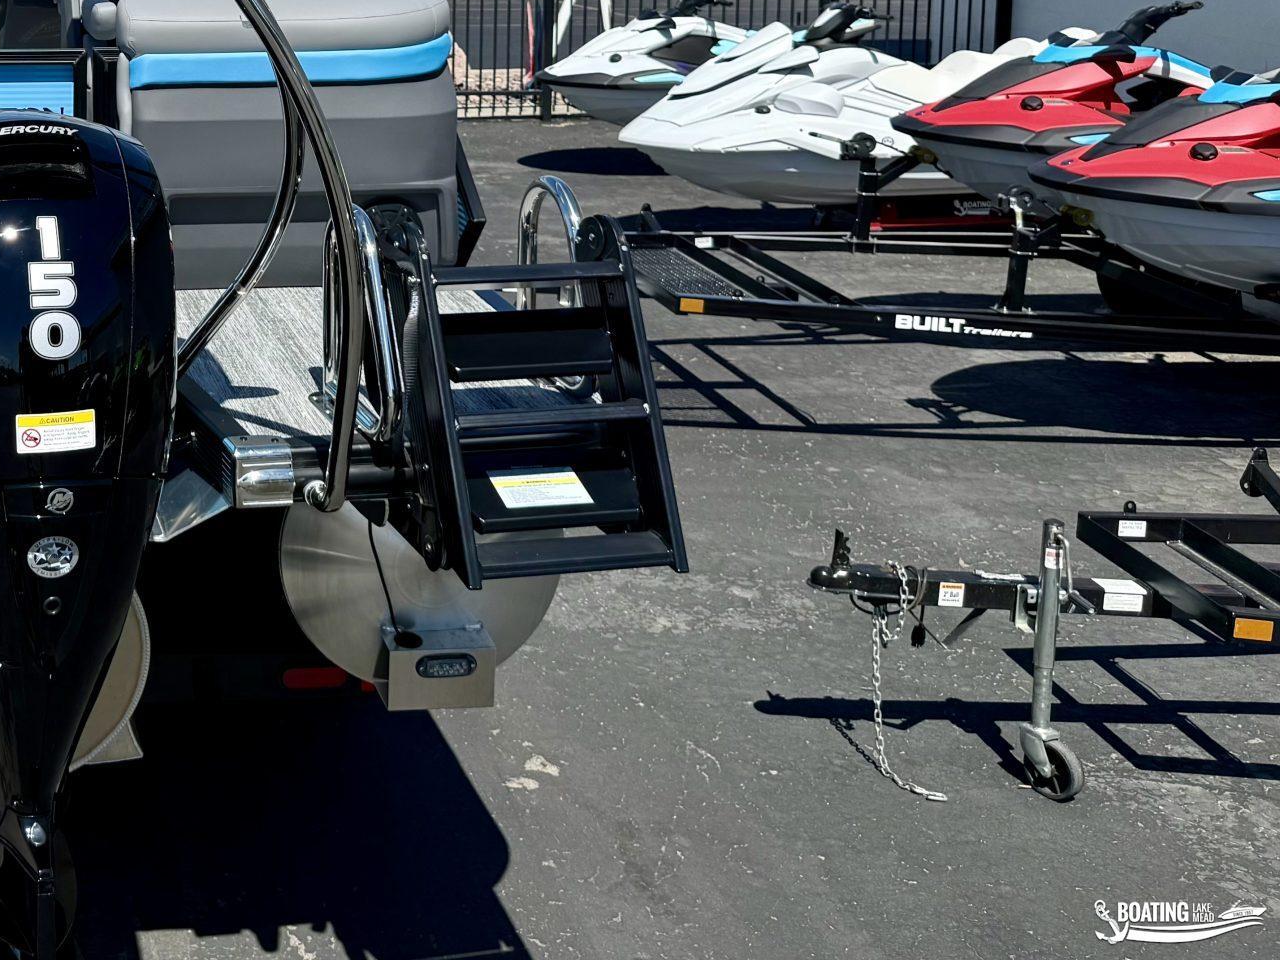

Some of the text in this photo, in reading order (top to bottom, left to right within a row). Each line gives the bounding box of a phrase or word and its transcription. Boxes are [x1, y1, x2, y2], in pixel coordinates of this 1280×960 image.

[895, 314, 1033, 338] BUILT Trailers
[46, 416, 75, 424] CAUTION
